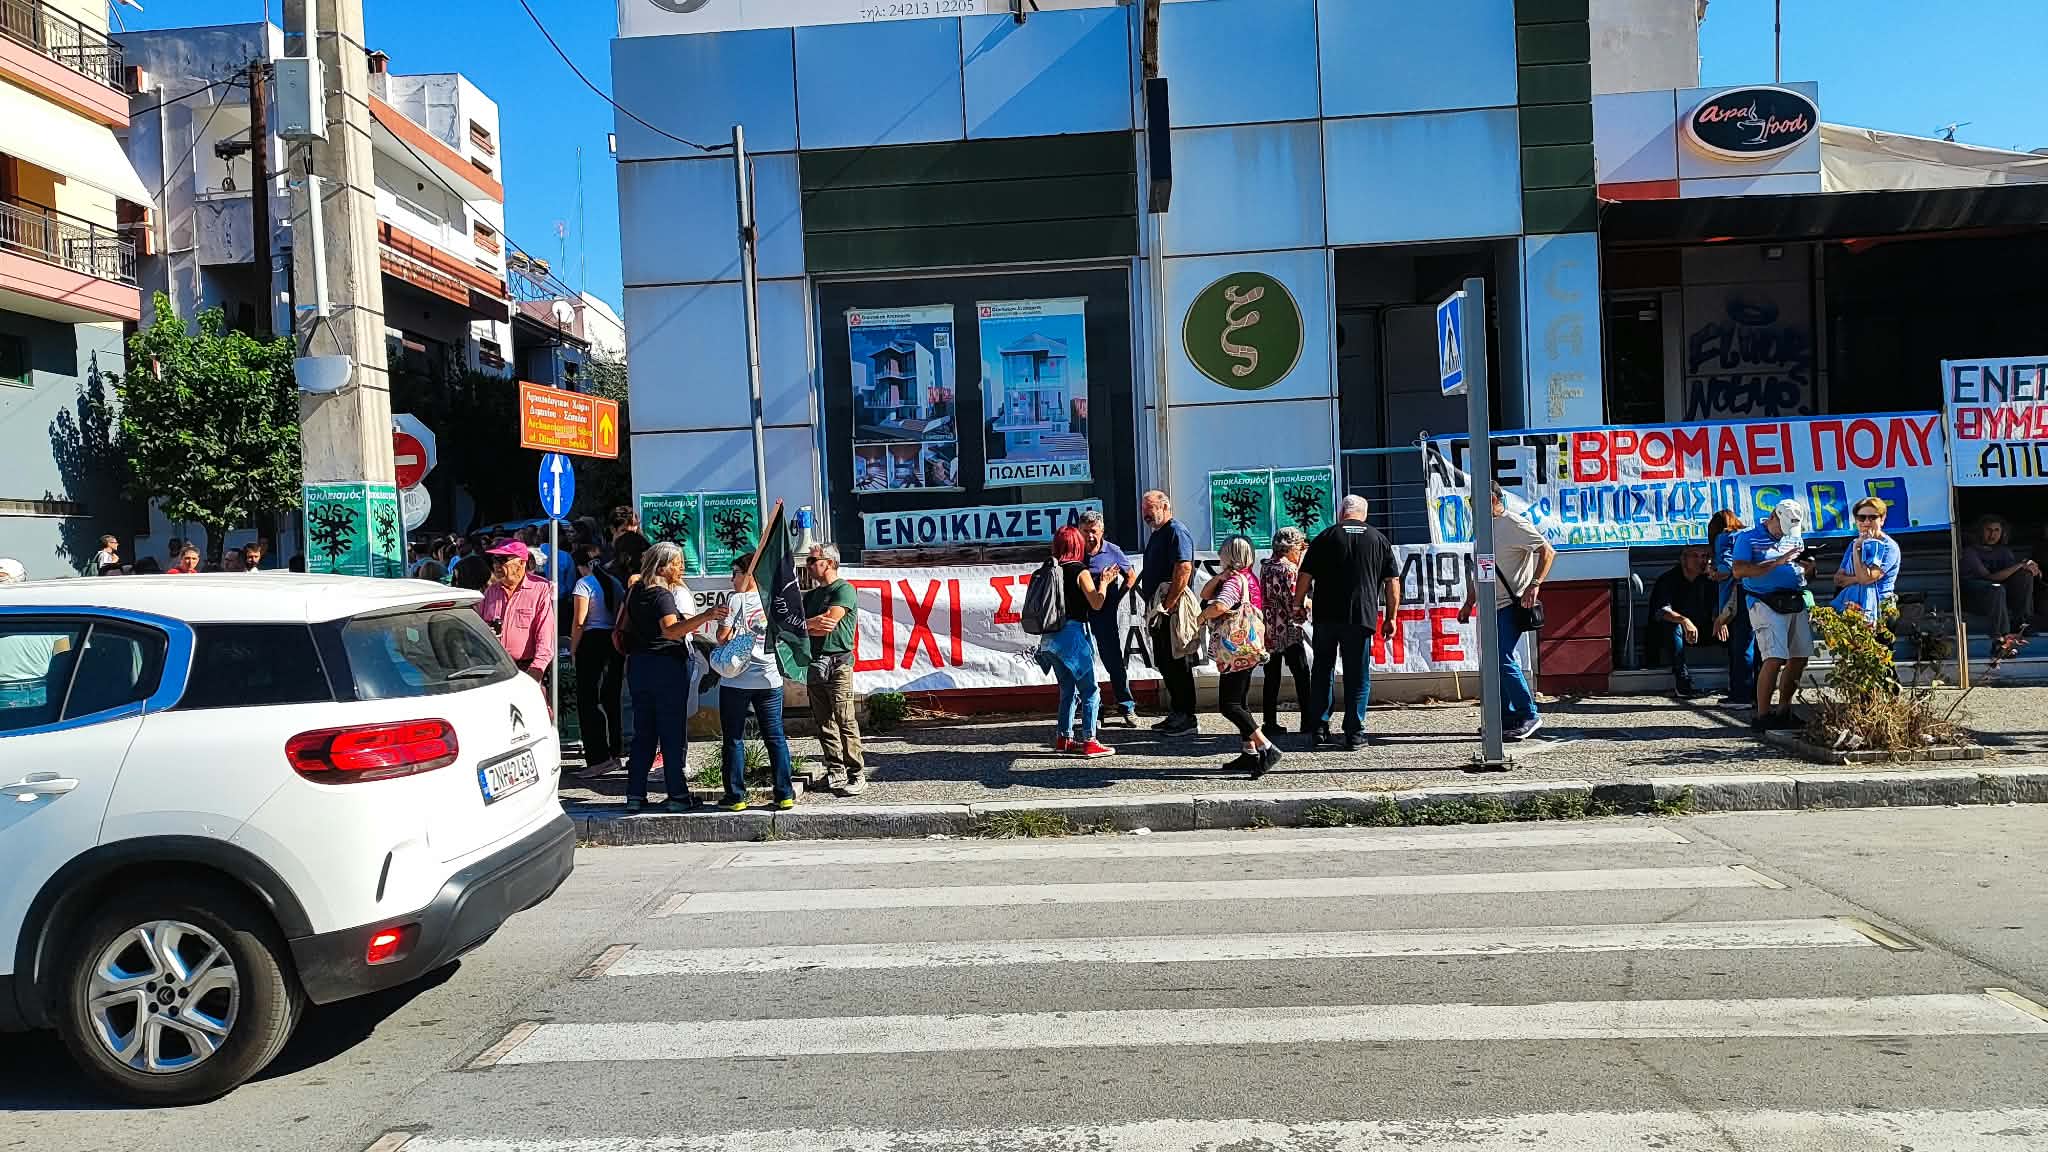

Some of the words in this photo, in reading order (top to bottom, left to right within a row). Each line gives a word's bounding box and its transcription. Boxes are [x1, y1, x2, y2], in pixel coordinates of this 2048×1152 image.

[889, 3, 930, 16] 24213
[935, 0, 974, 13] 12205
[1763, 113, 1808, 139] foods
[1810, 416, 1938, 472] ΠΟΛΥ
[989, 463, 1065, 480] ΠΩΛΕΙΤΑΙ
[876, 505, 1094, 545] ΕΝΟΙΚΙΑΖΕΤΑ
[693, 591, 736, 608] ΘΕΛ
[847, 578, 963, 672] ΟΧΙ
